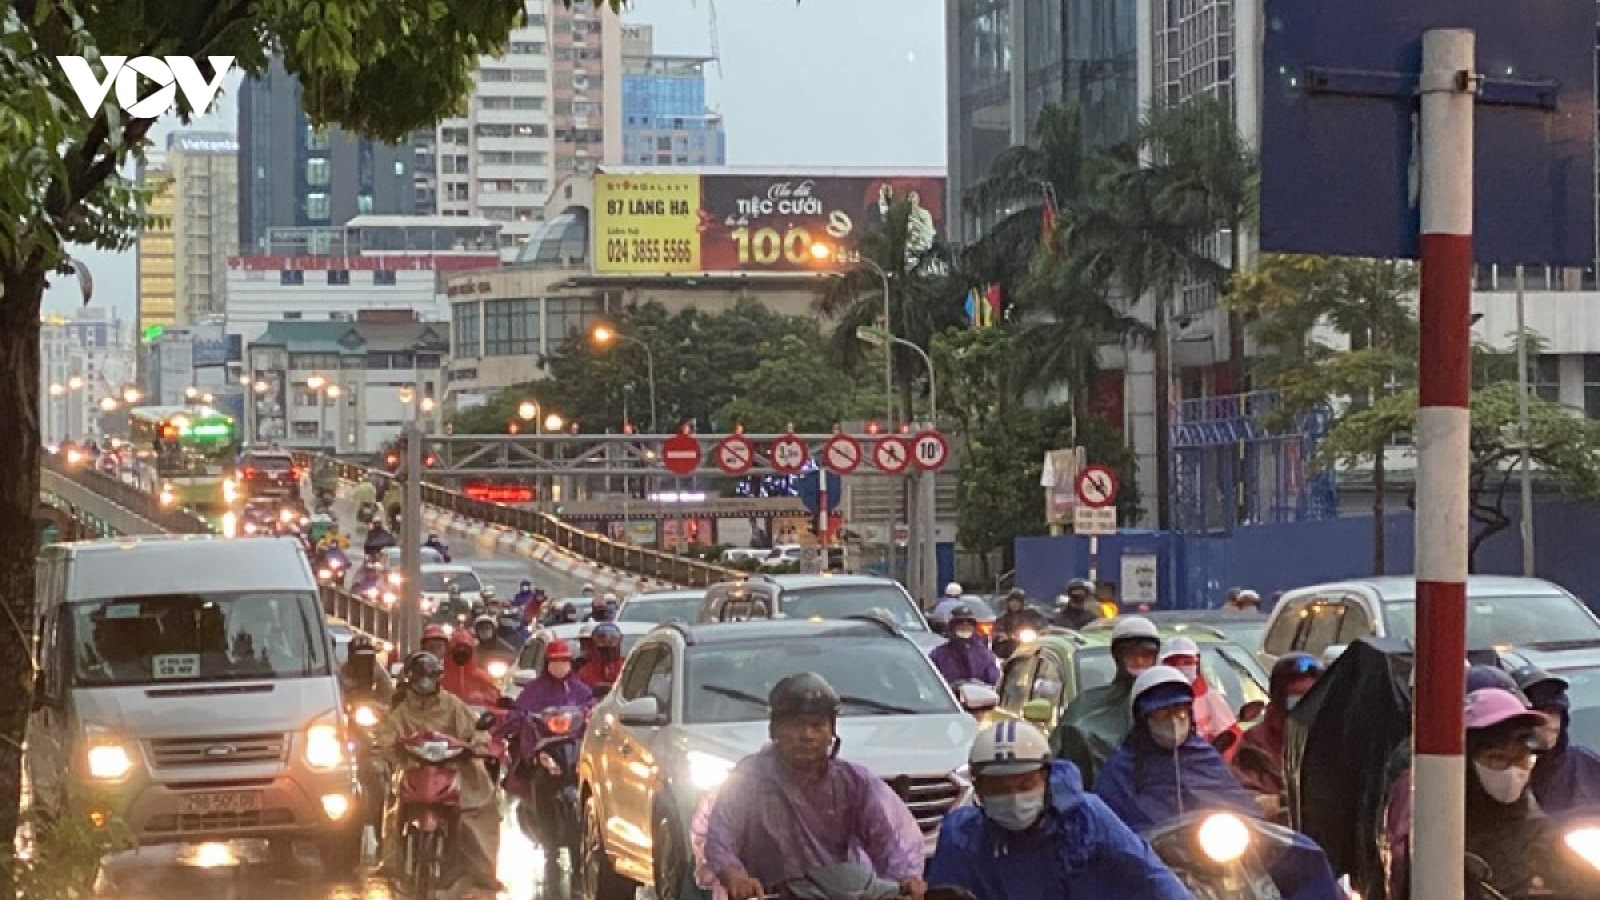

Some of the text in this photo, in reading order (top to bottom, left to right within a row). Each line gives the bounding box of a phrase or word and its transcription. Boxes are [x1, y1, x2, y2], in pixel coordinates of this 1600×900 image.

[607, 199, 624, 215] 87
[736, 194, 822, 218] TIỆC CƯỚI
[607, 238, 628, 262] 024
[731, 226, 812, 265] 100
